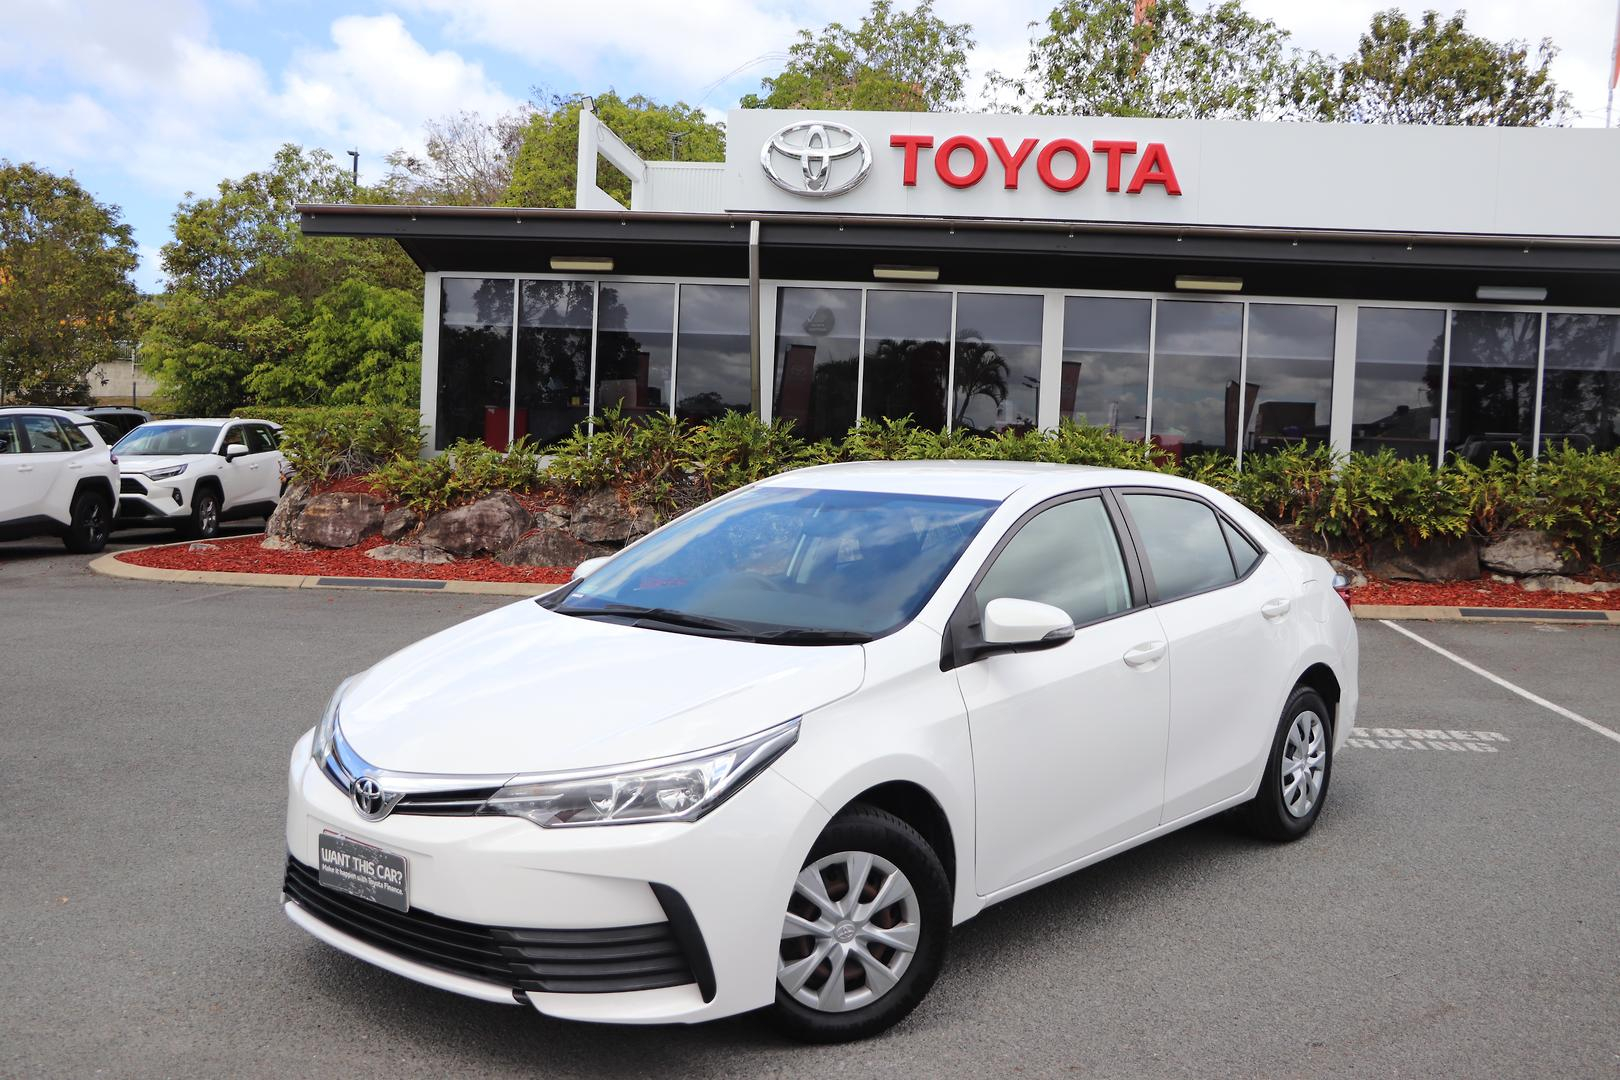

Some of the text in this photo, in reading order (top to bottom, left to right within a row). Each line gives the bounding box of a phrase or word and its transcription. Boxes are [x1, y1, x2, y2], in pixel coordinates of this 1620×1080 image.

[890, 134, 1182, 196] TOYOTA
[1342, 738, 1499, 752] RKING
[321, 848, 403, 885] WANT THIS CAR?
[368, 877, 384, 889] Toyota
